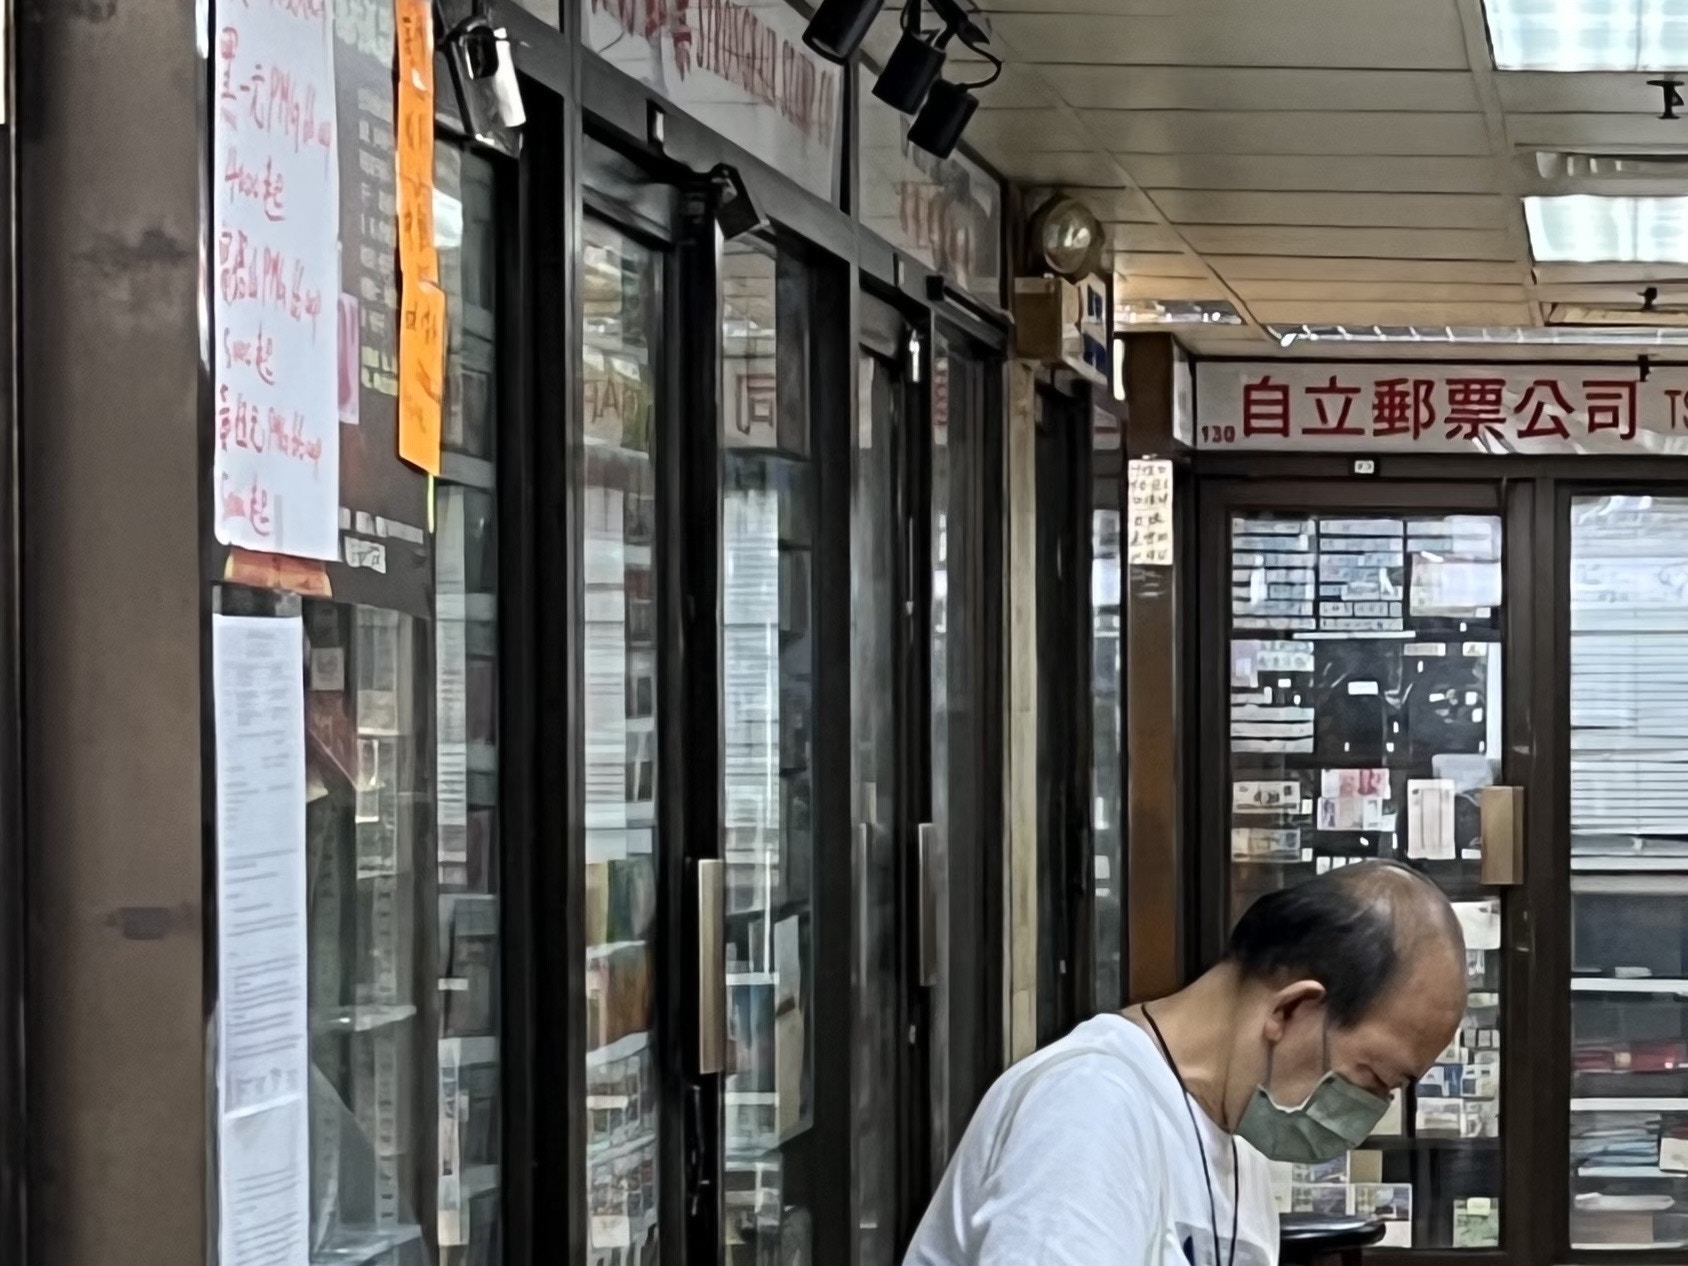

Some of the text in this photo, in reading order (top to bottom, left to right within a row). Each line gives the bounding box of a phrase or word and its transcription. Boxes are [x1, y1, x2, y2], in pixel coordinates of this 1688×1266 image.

[1242, 375, 1638, 440] 自立郵票公司
[1201, 425, 1236, 443] 130
